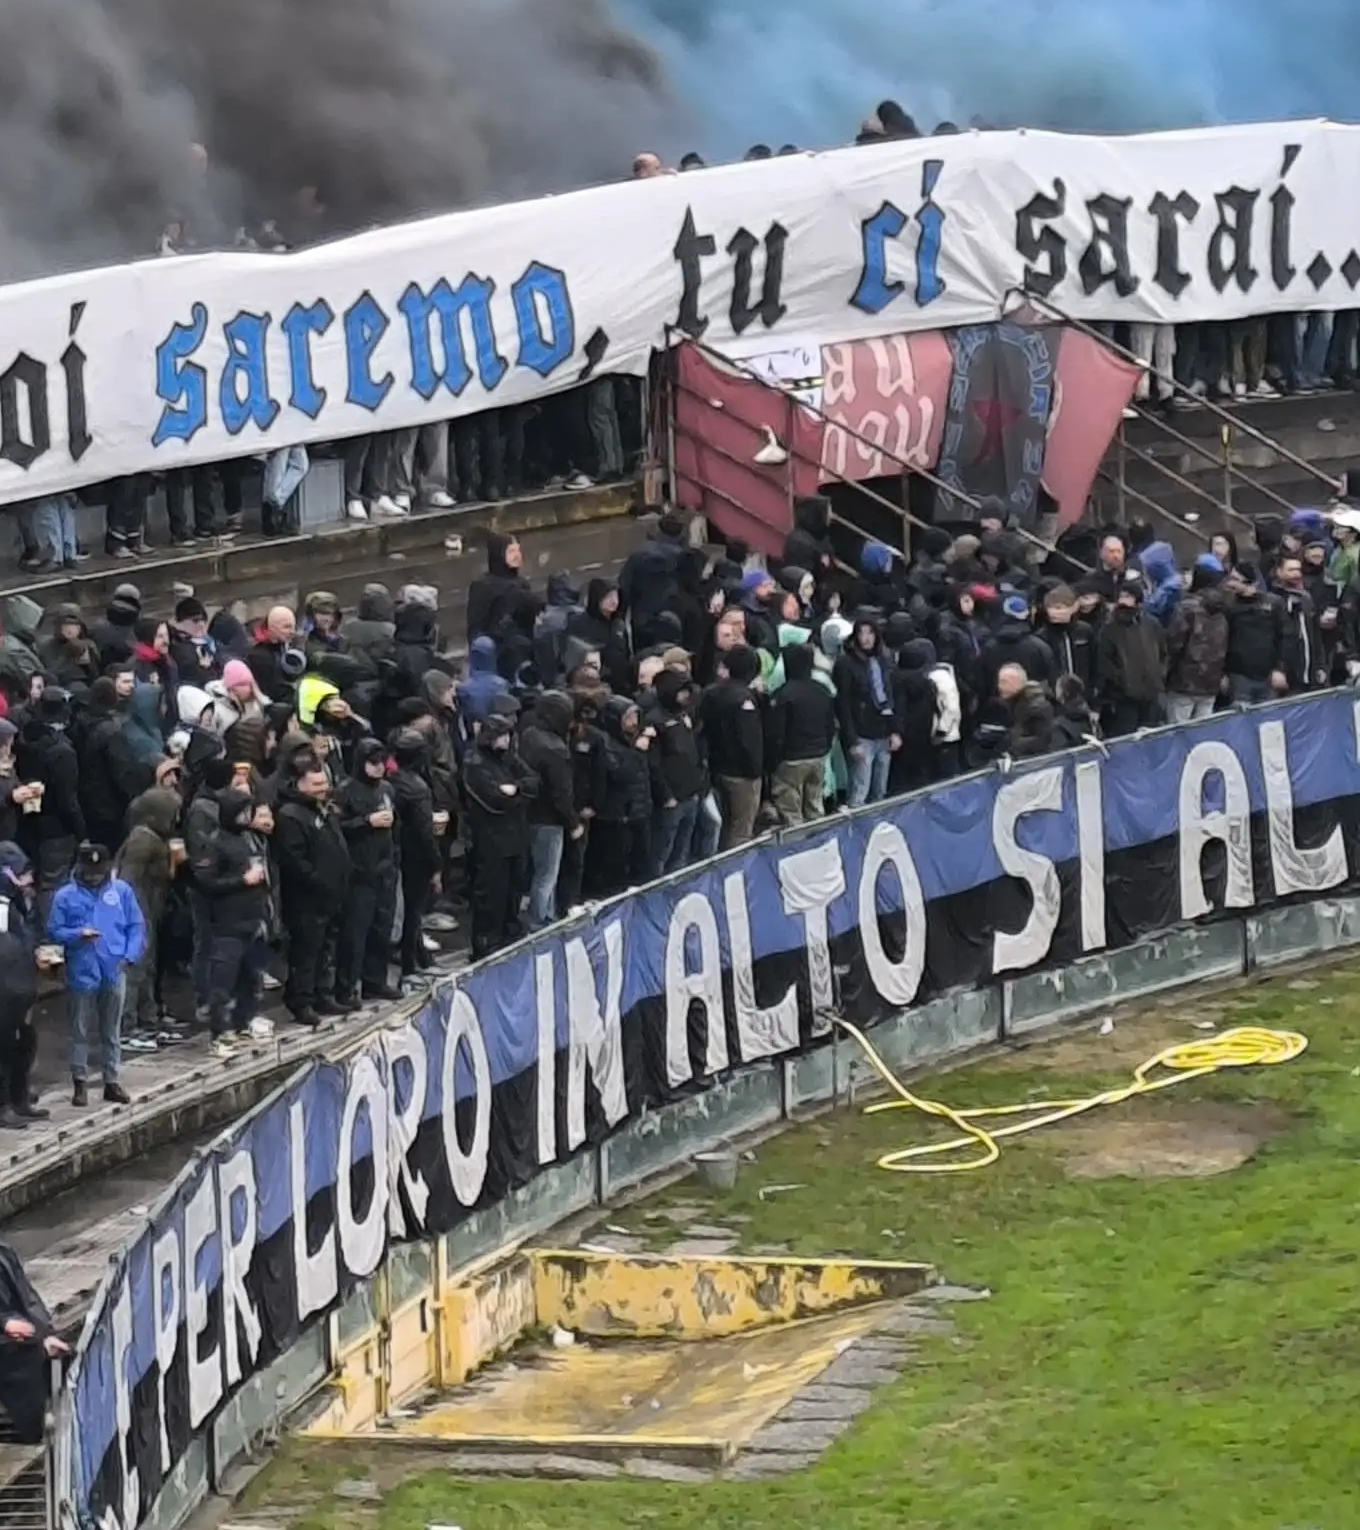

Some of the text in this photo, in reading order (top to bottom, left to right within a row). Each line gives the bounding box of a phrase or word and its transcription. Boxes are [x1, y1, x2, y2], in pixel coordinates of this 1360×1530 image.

[152, 259, 610, 449] saremo,
[672, 204, 790, 338] tu
[847, 159, 948, 315] ci
[152, 1150, 262, 1476] PER
[290, 988, 492, 1323] LORO
[536, 917, 629, 1165] IN
[665, 820, 927, 1089] ALTO
[992, 760, 1106, 975] SI
